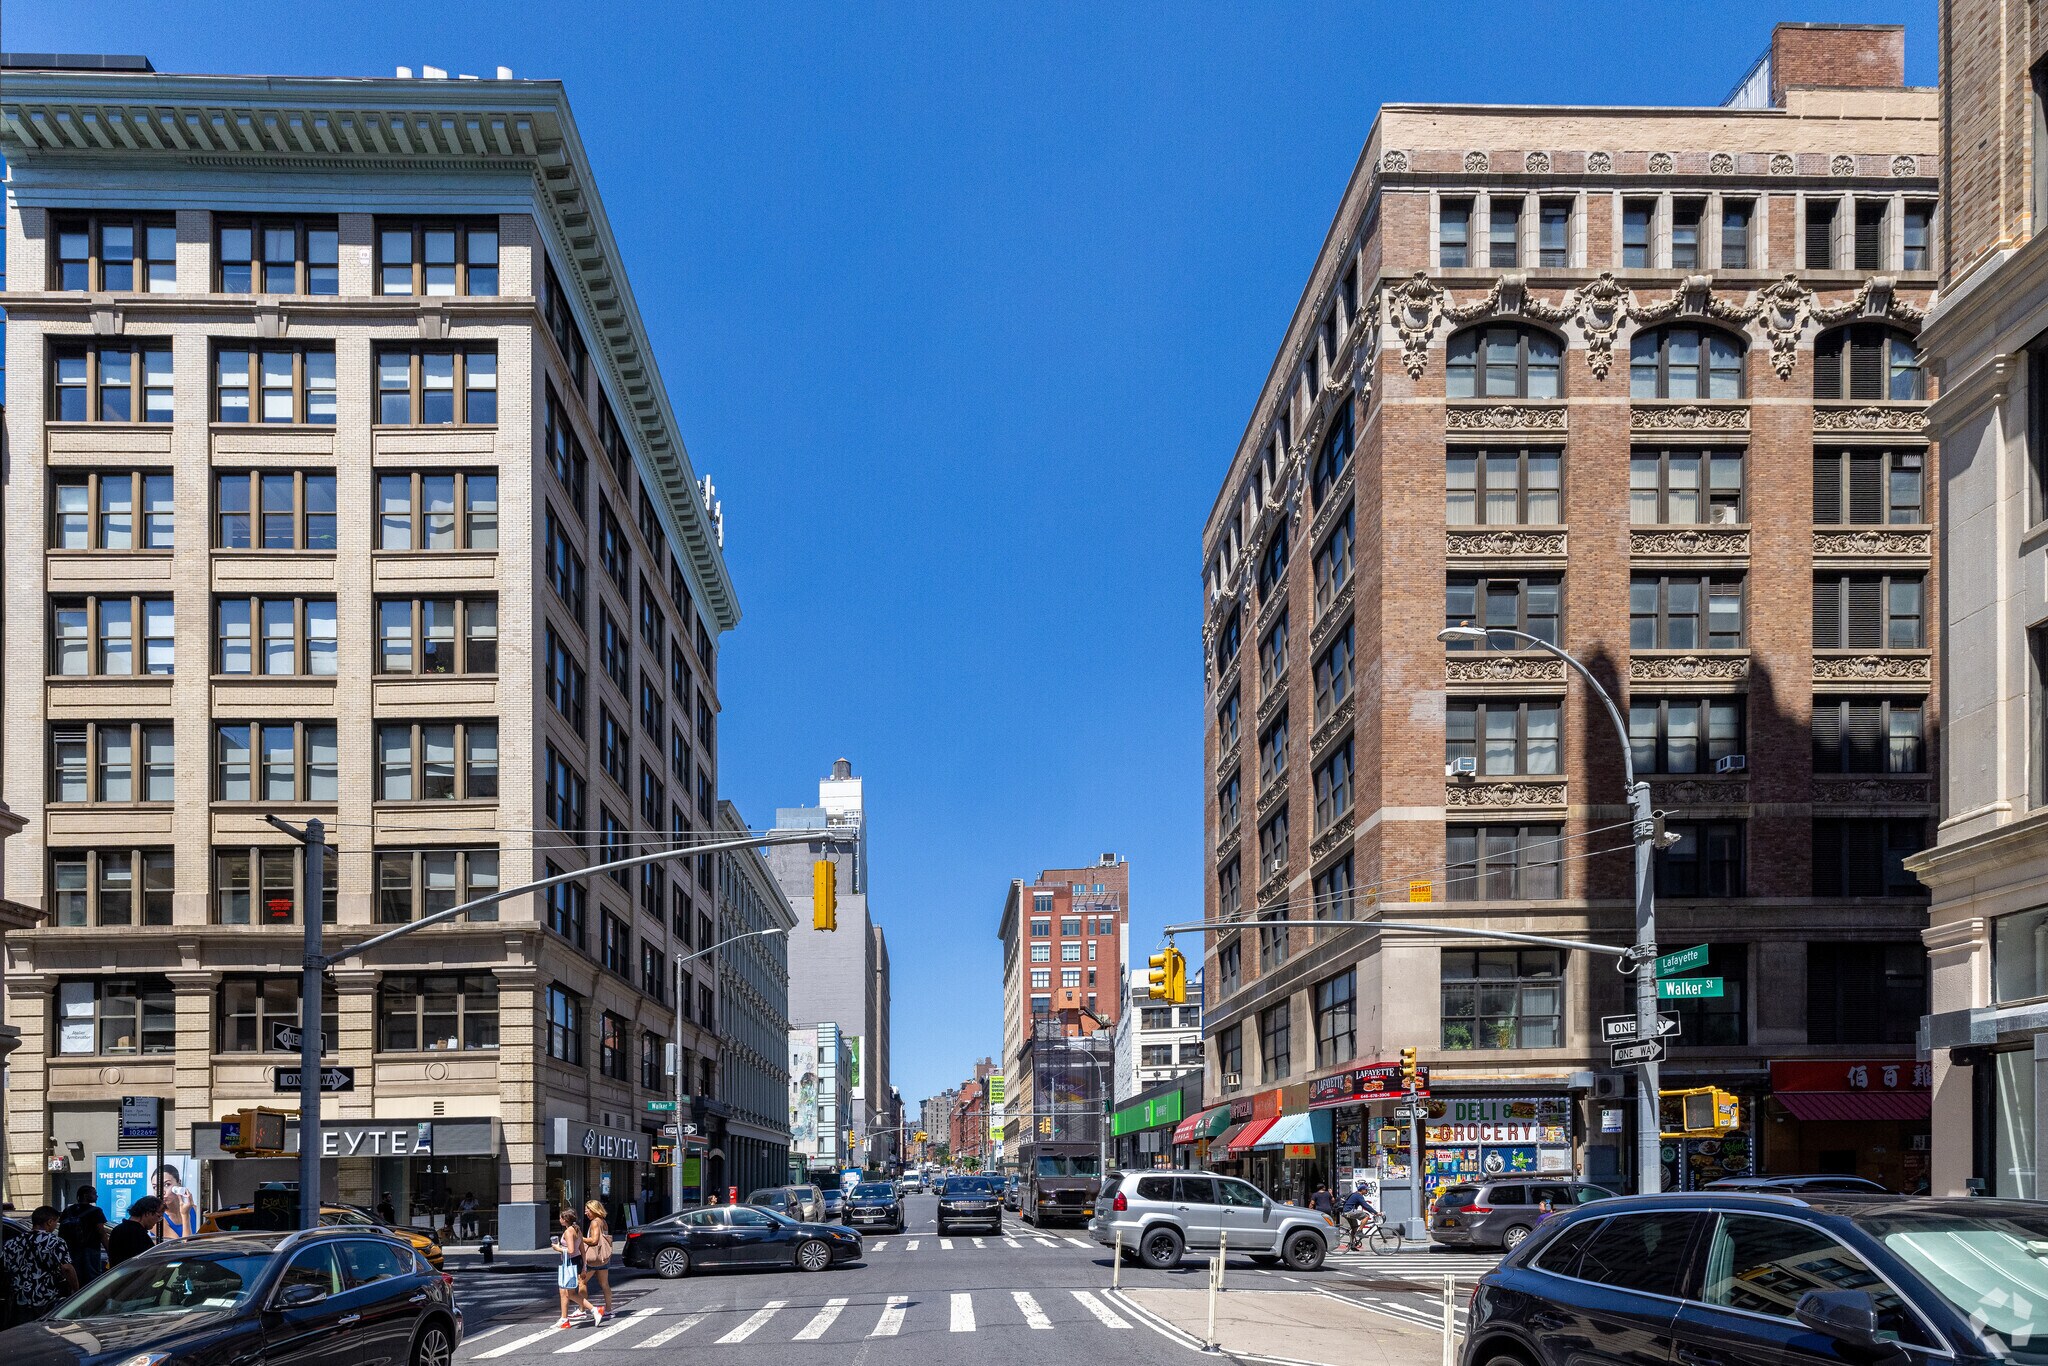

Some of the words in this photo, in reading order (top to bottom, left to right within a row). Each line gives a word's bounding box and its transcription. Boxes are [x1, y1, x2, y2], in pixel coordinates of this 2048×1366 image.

[1662, 950, 1699, 968] Lafayette
[1663, 966, 1675, 974] Street
[1665, 981, 1703, 996] Walker
[1705, 979, 1714, 989] St
[1614, 1023, 1636, 1033] ONE
[1657, 1020, 1668, 1030] AY
[282, 1032, 299, 1045] ONE
[1618, 1048, 1634, 1059] ONE
[1640, 1045, 1657, 1057] WAY
[286, 1074, 302, 1085] ON
[1355, 1067, 1395, 1080] LAFAYETTE
[1317, 1075, 1344, 1095] LAFAYETTE
[125, 1097, 132, 1106] 2
[651, 1102, 668, 1110] Walker
[1397, 1109, 1408, 1117] ONE
[1455, 1102, 1497, 1121] DELI
[1502, 1103, 1513, 1119] &
[1440, 1122, 1532, 1141] GROCERY
[598, 1134, 640, 1160] HEYTEA
[114, 1178, 137, 1186] SOLID
